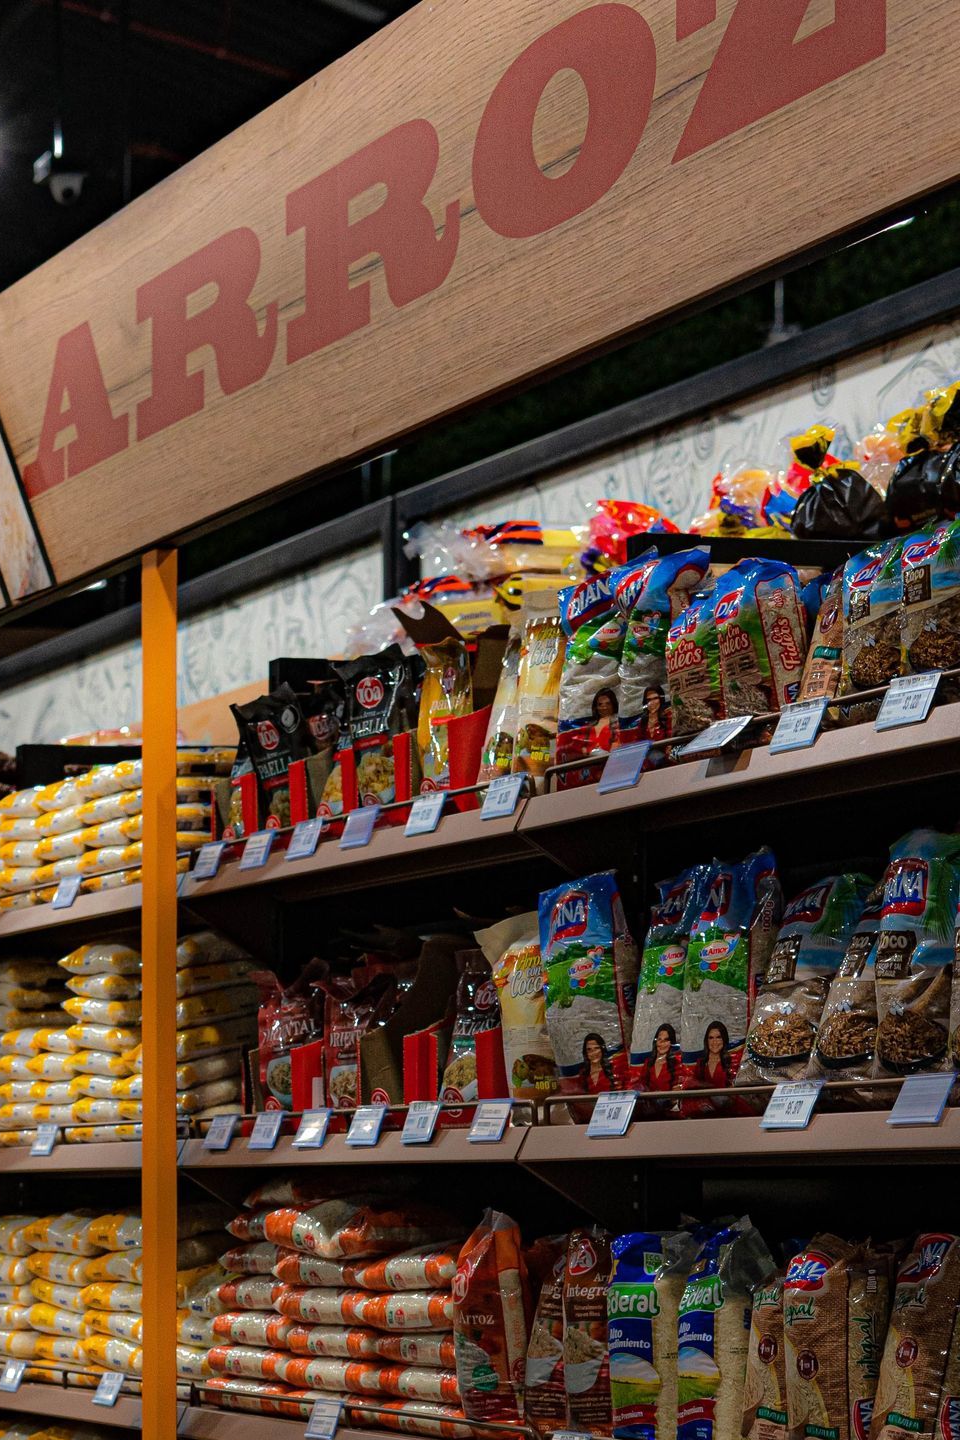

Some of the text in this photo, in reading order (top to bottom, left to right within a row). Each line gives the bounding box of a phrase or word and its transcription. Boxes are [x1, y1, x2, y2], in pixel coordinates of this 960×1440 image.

[23, 0, 888, 497] ARROZ
[677, 640, 694, 653] Con
[781, 617, 802, 671] Fideos
[256, 756, 288, 781] PAELL
[517, 951, 541, 974] Arro
[698, 945, 729, 959] VitAmor
[566, 1283, 609, 1299] Integra
[607, 1291, 658, 1315] deral
